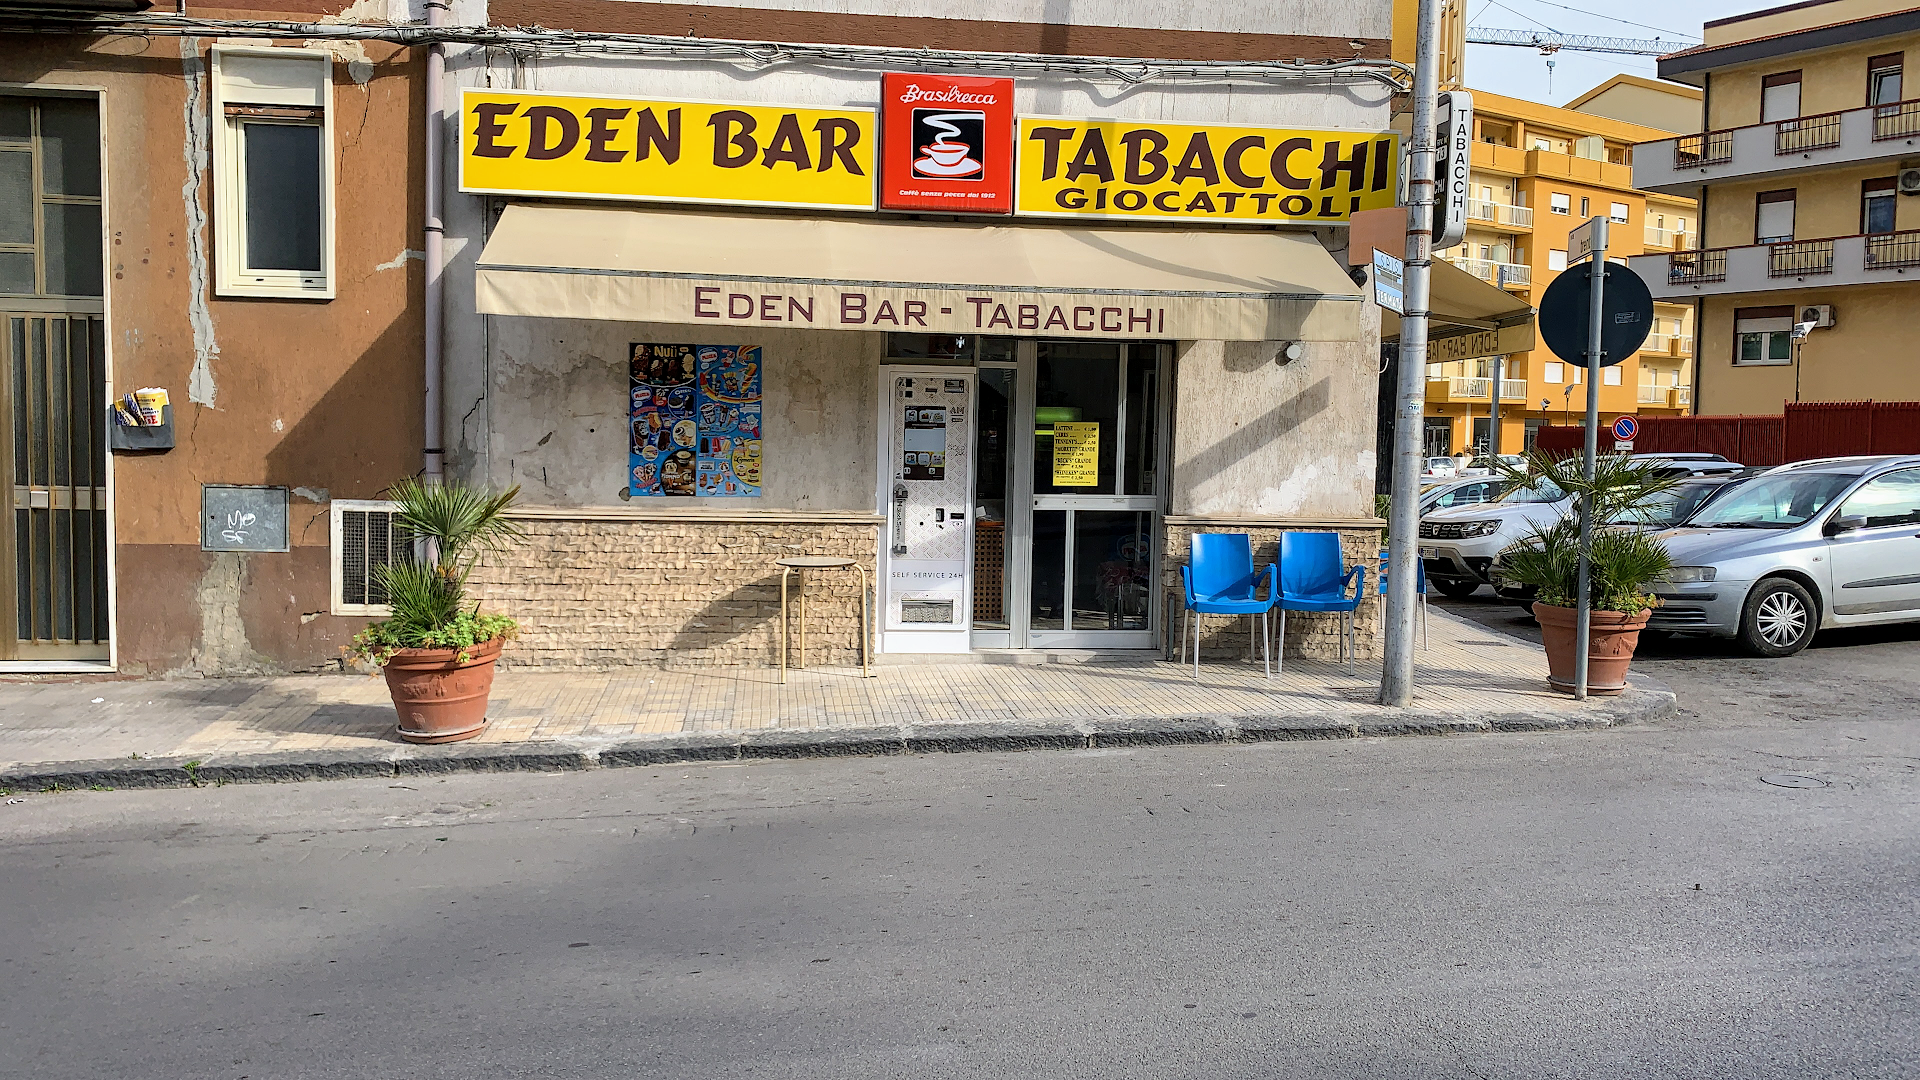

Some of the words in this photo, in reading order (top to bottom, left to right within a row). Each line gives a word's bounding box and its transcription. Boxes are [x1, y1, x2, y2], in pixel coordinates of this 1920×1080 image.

[900, 84, 998, 105] Brasilrecca
[471, 102, 681, 166] EDEN
[706, 109, 866, 177] BAR
[1028, 126, 1392, 193] TABACCHI
[1453, 109, 1468, 223] TABACCHI
[1055, 187, 1360, 218] GIOCATTOLI
[694, 286, 814, 324] EDEN
[839, 291, 928, 327] BAR
[967, 297, 1164, 333] TABACCHI
[891, 571, 910, 579] SELF
